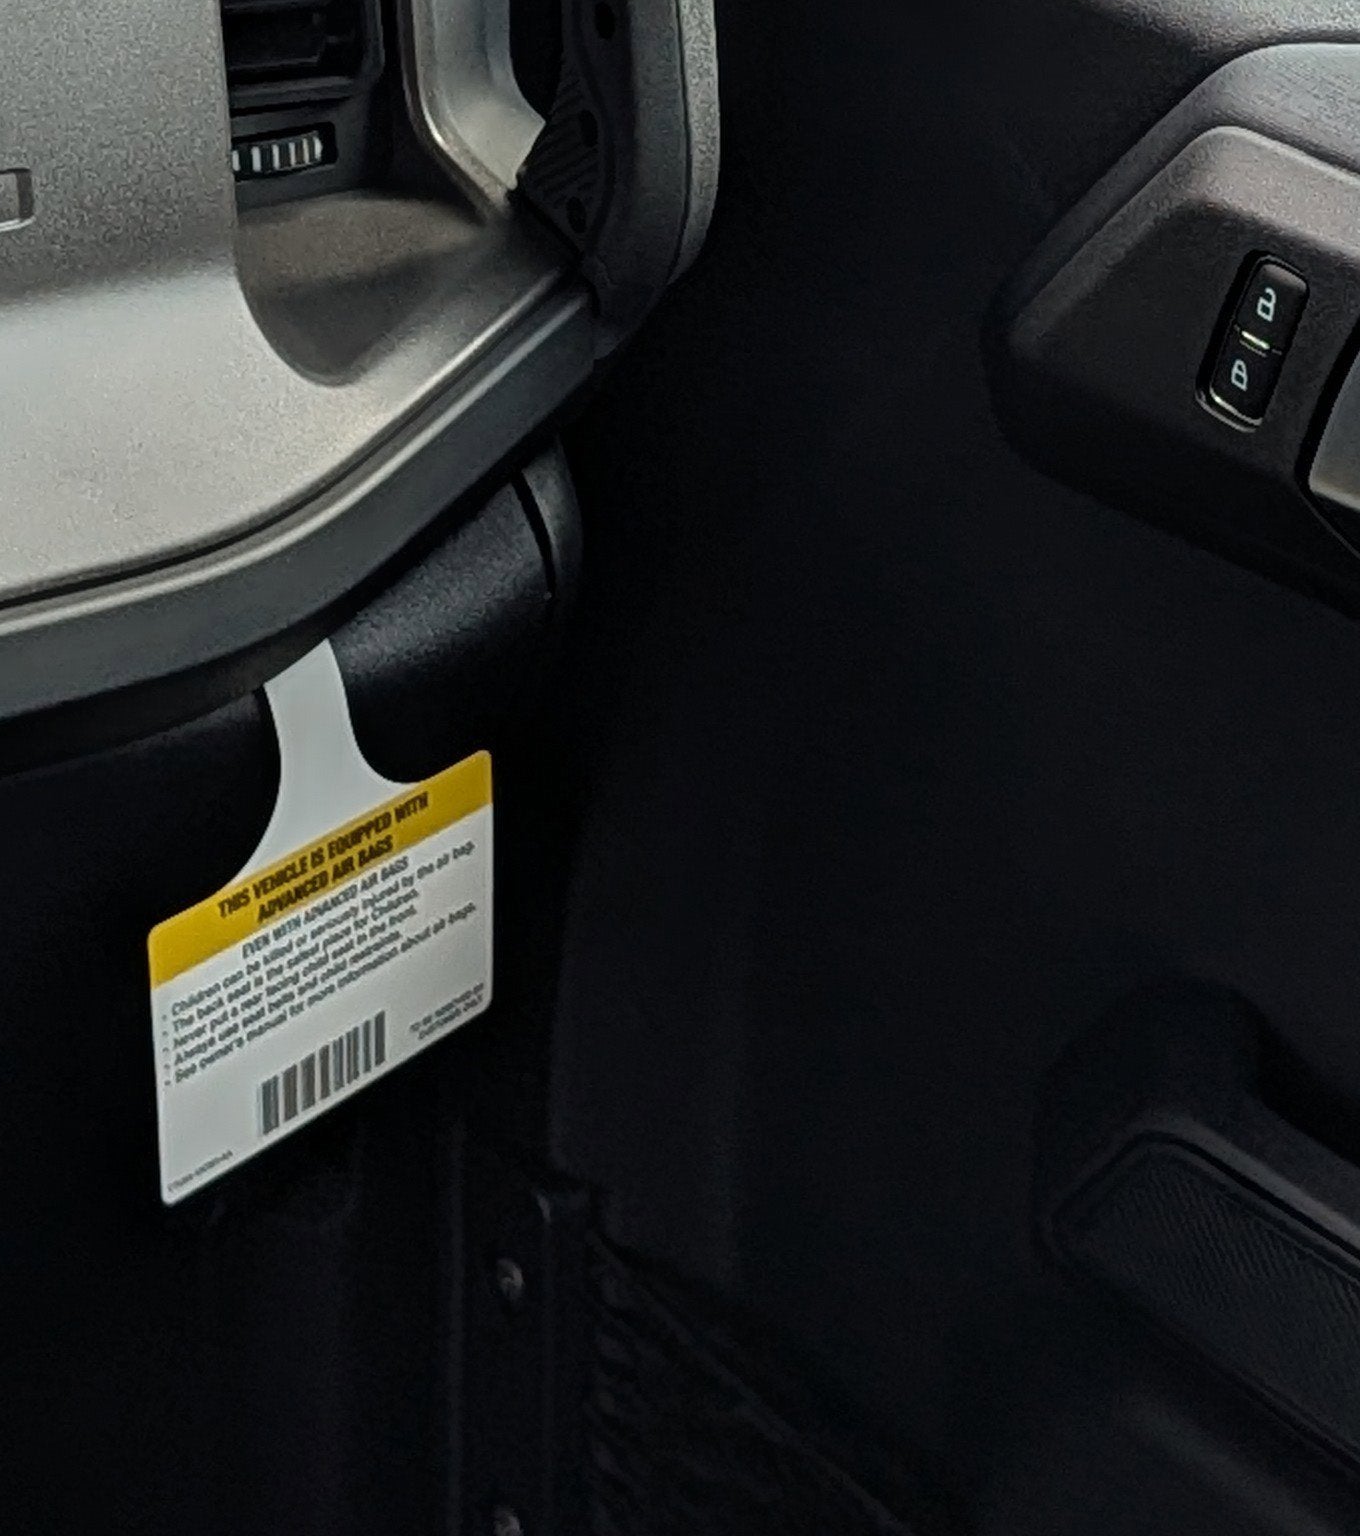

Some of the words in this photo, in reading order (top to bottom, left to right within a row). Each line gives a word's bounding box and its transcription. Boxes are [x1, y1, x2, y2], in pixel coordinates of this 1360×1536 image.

[217, 887, 251, 918] THIS
[252, 855, 308, 899] VEHICLE
[310, 846, 325, 869] IS
[327, 811, 392, 860] EQUIPPED
[394, 790, 429, 824] WITH
[258, 870, 329, 923] ADVANCED
[332, 855, 355, 883] AIR
[357, 834, 393, 868] BAGS
[242, 932, 270, 960] EVEN
[303, 883, 359, 924] ADVANCED
[360, 872, 378, 893] AIR
